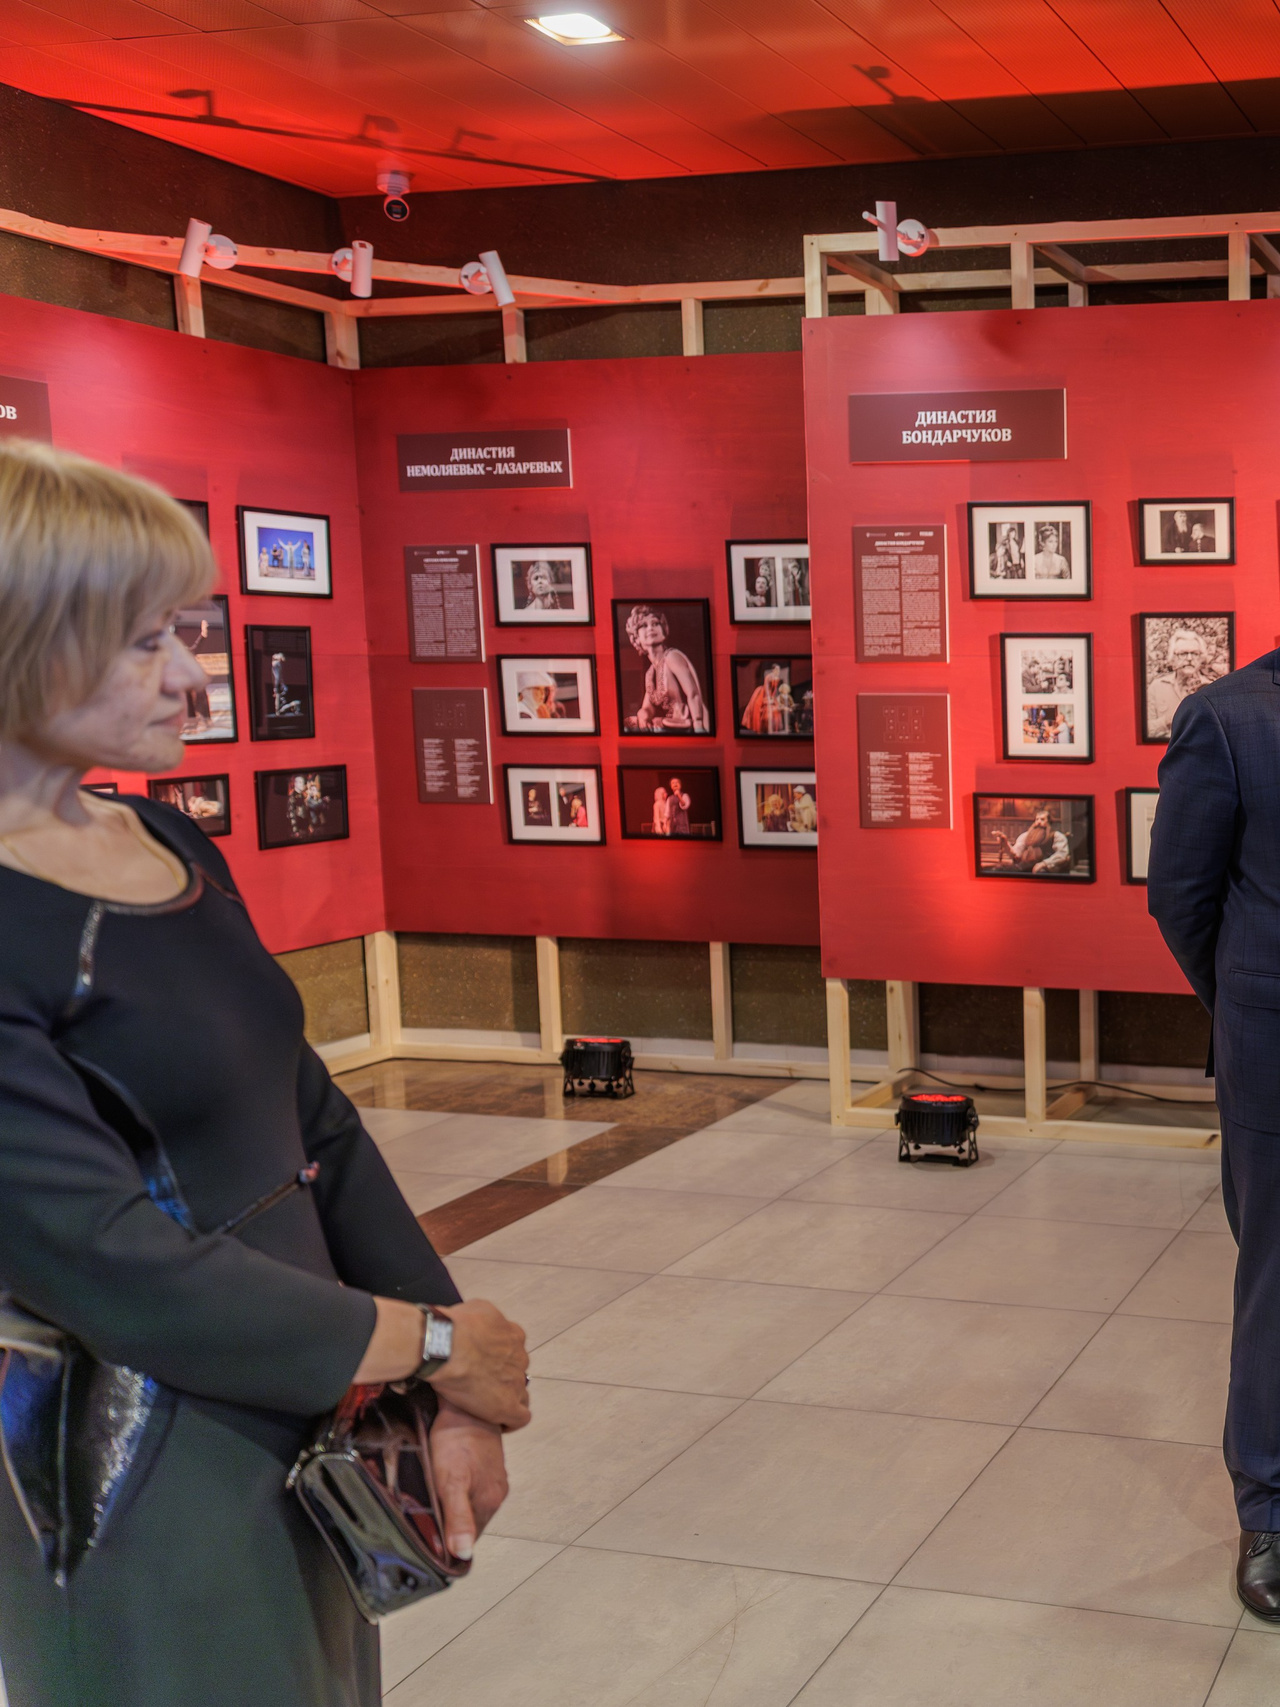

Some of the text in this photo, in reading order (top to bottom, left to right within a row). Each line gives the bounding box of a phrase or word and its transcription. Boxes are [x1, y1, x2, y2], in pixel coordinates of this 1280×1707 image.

[915, 409, 997, 427] ДИНАСТИЯ
[901, 428, 1012, 446] БОНДАРЧУКОВ
[450, 446, 515, 462] ДИНАСТИЯ
